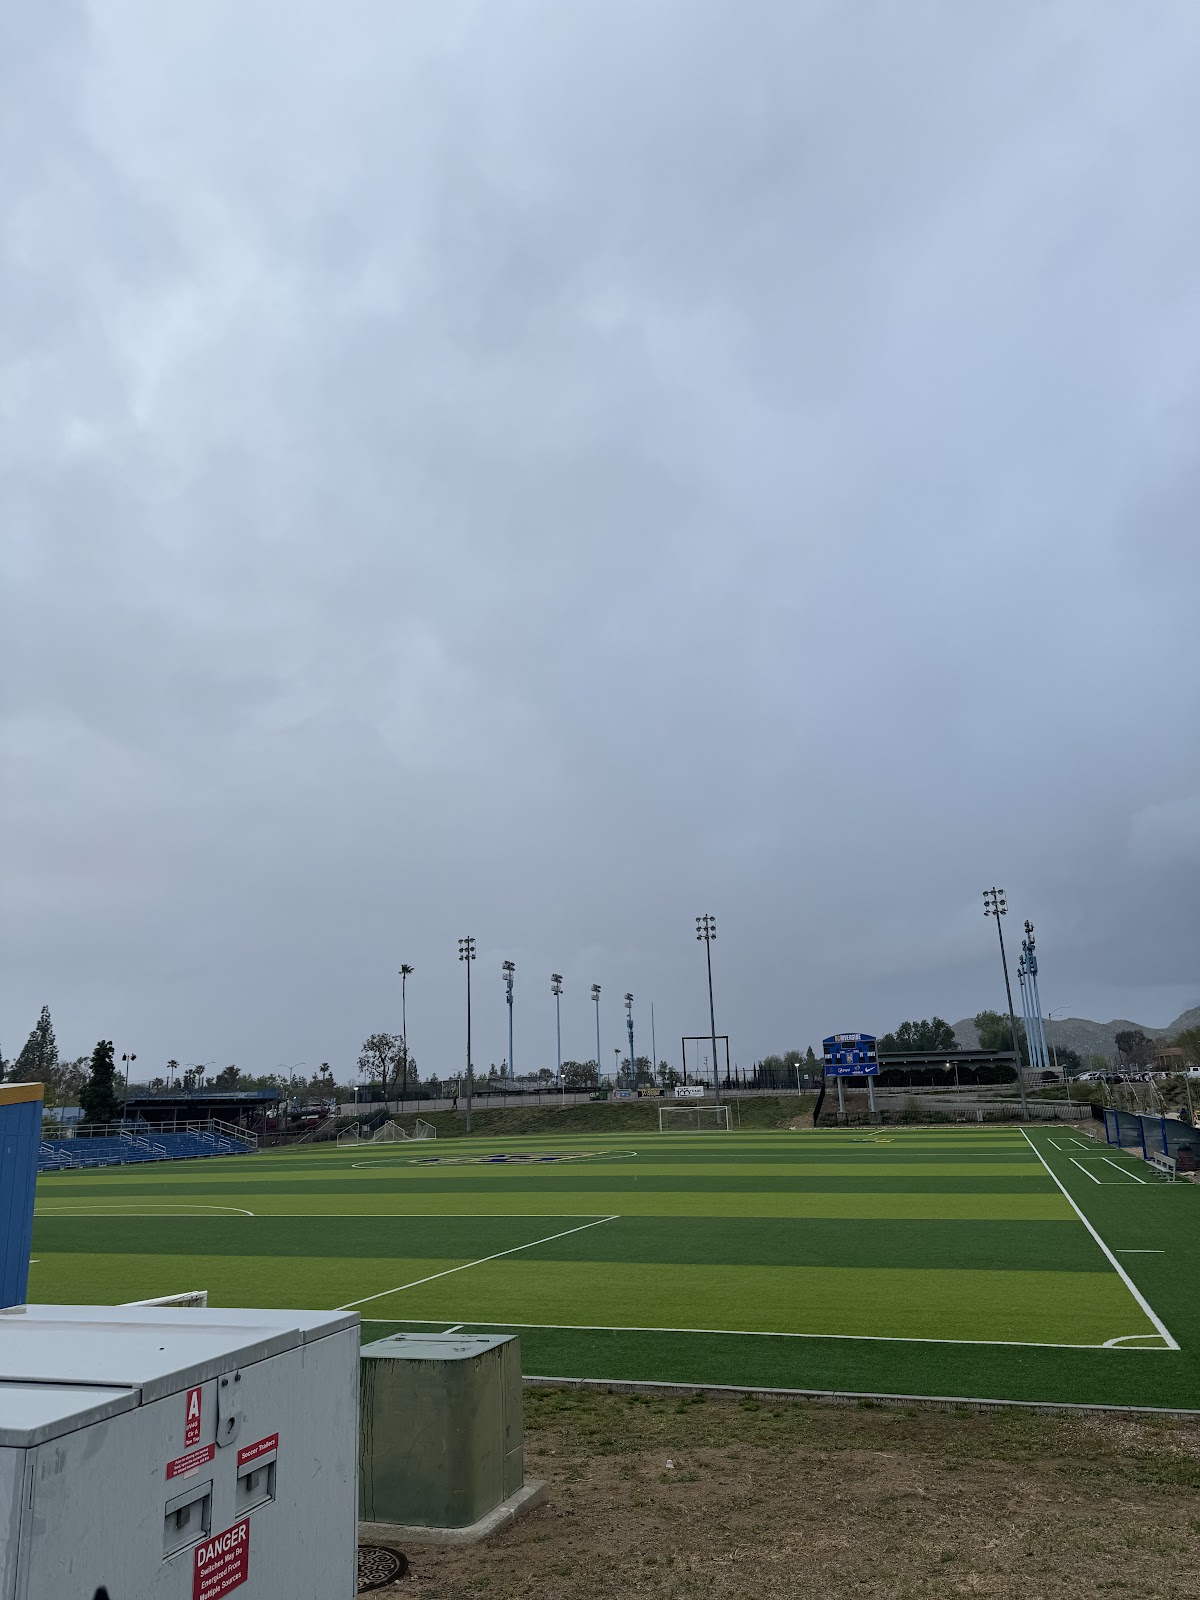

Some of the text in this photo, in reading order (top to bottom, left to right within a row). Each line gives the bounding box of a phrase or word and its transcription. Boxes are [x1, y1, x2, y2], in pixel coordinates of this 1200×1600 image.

[188, 1391, 199, 1420] A
[241, 1439, 275, 1460] Soccer Trailers
[197, 1524, 247, 1568] DANGER
[200, 1547, 243, 1578] Switches May Be
[201, 1560, 241, 1590] Energized From
[221, 1571, 242, 1589] Sources
